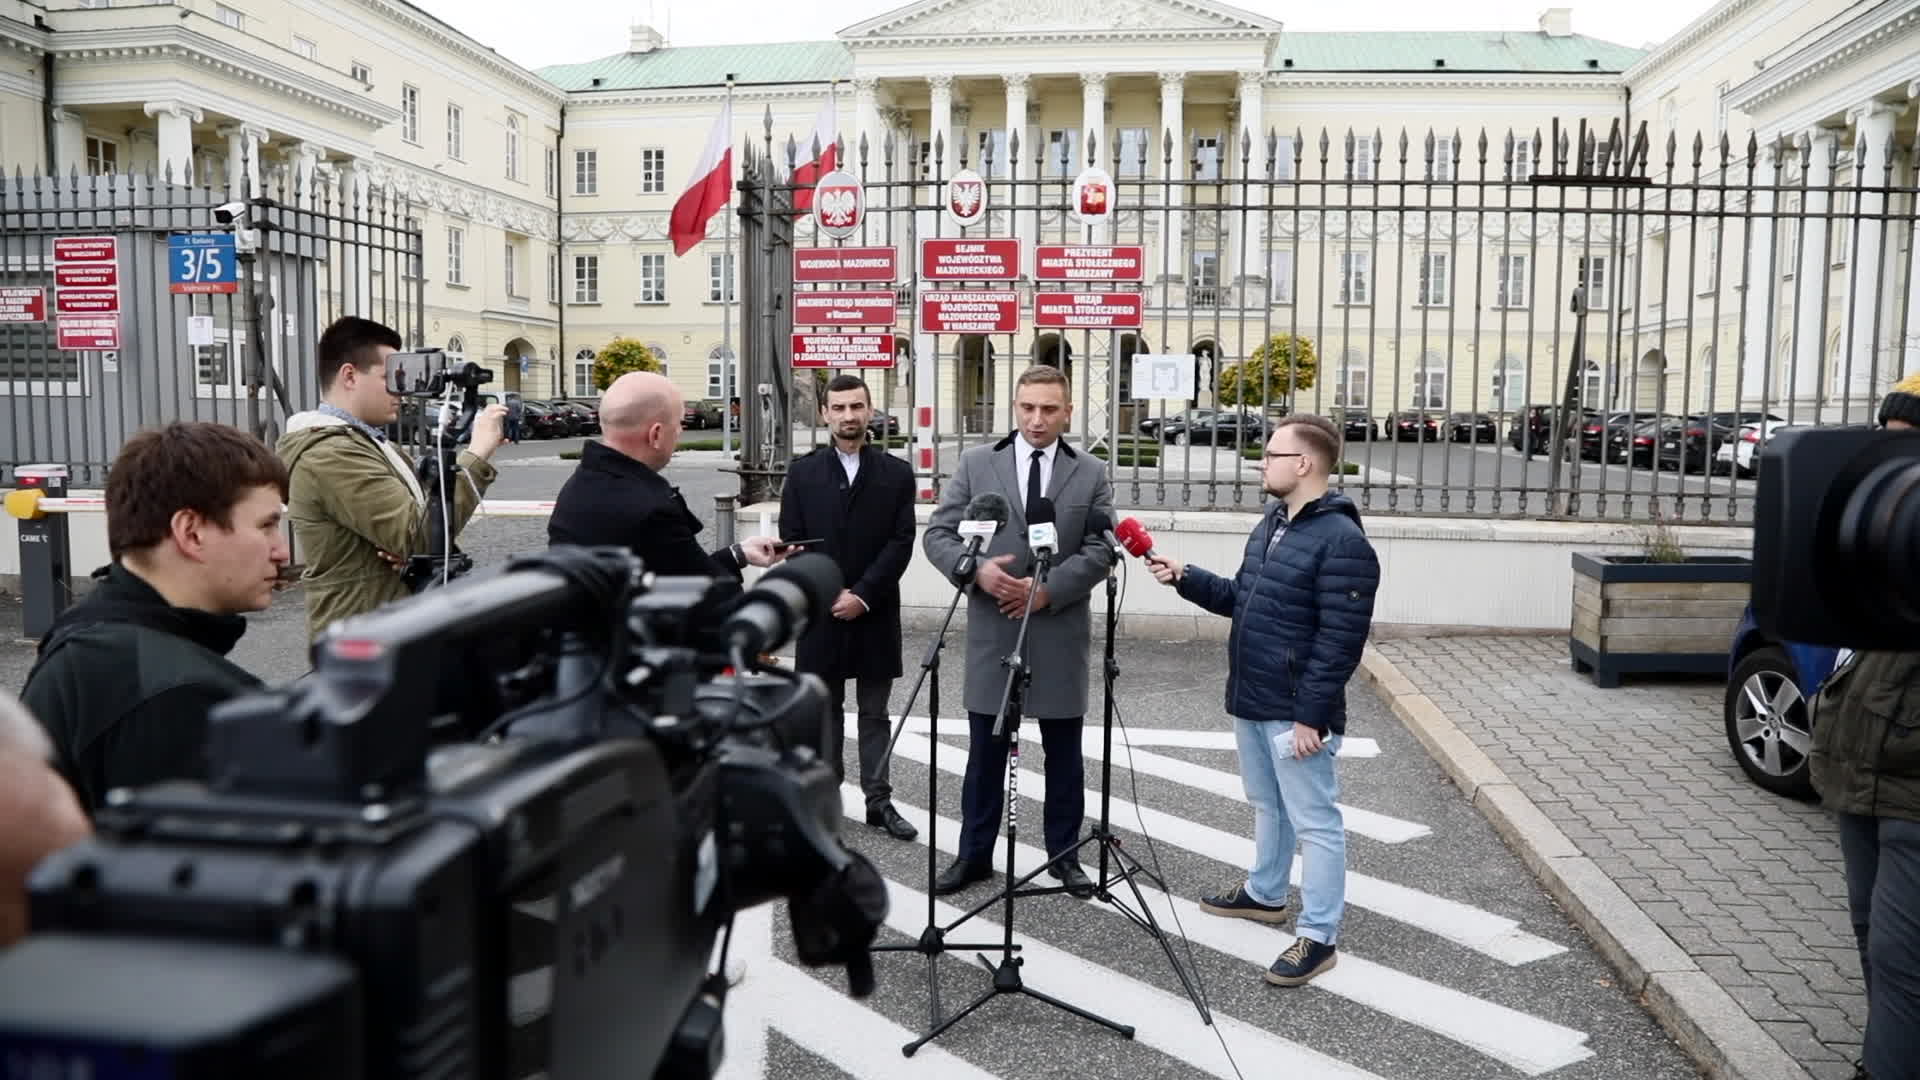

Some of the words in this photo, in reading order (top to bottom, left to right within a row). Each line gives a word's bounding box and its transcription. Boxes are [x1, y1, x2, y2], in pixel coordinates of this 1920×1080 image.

[955, 244, 985, 253] SEJMIK
[1064, 248, 1113, 257] PREZYDENT
[800, 259, 841, 268] WOJEWODA
[843, 258, 890, 268] MAZOWIECKI
[938, 254, 1002, 263] WOJEWÓDZTWA
[1041, 258, 1073, 268] MIASTA
[1075, 258, 1136, 268] STOŁECZNEGO
[181, 248, 221, 283] 3/5
[936, 266, 1005, 275] MAZOWIECKIEGO
[1065, 269, 1114, 278] WARSZAWY
[925, 294, 949, 303] URZĄD
[951, 294, 1015, 302] MARSZAŁKOWSKI
[1073, 295, 1103, 305] URZĄD
[941, 303, 999, 311] WOJEWÓDZTWA
[1041, 305, 1073, 314] MIASTA
[1075, 305, 1135, 314] STOŁECZNEGO
[938, 312, 1001, 321] MAZOWIECKIEGO
[1065, 316, 1113, 325] WARSZAWY
[943, 322, 950, 330] W
[951, 322, 996, 330] WARSZAWIE
[805, 344, 816, 353] DO
[816, 344, 841, 353] SPRAW
[794, 353, 800, 361] O
[846, 353, 890, 361] MEDYCZNYCH
